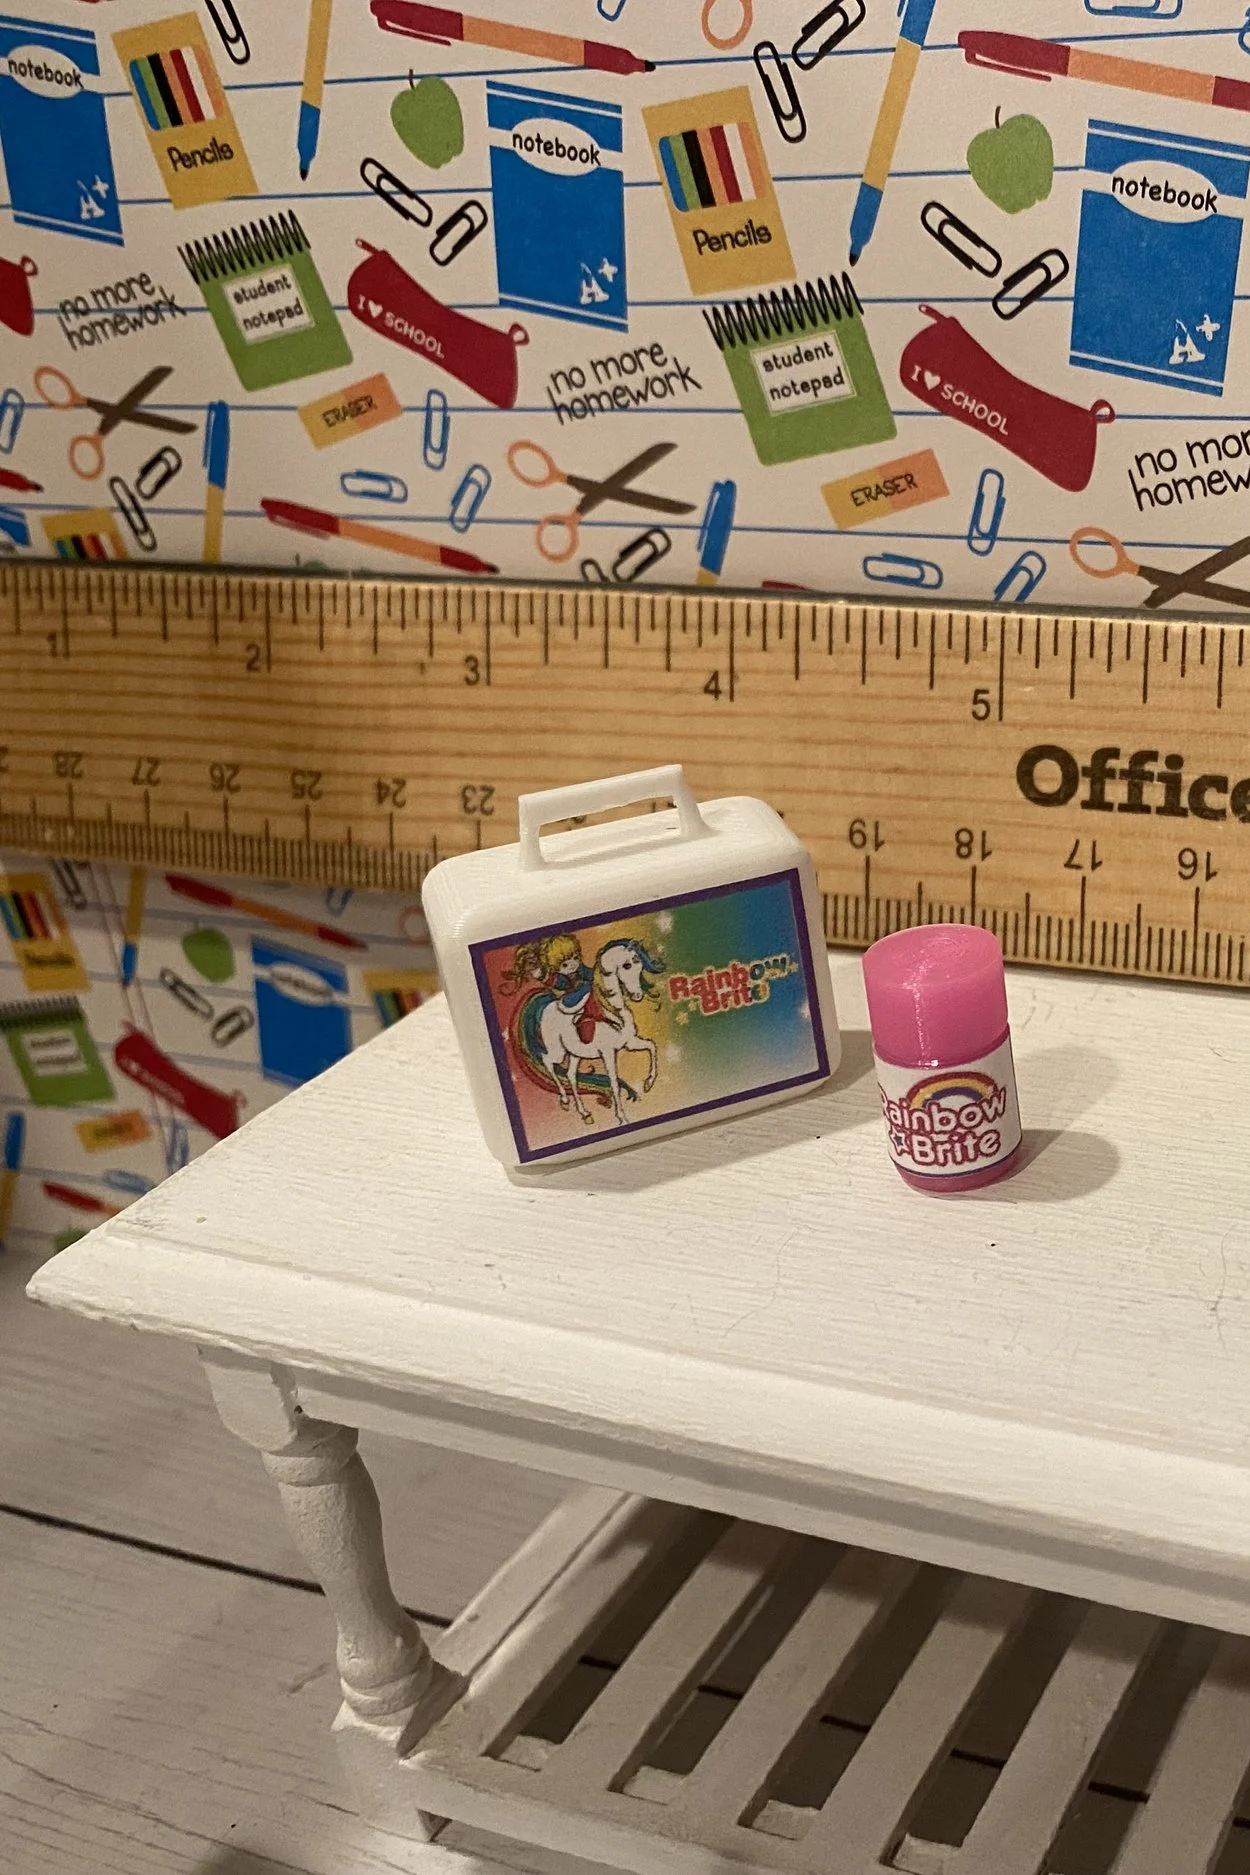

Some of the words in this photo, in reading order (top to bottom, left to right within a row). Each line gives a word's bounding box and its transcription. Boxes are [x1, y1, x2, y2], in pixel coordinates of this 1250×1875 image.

[8, 57, 84, 89] notebook
[167, 137, 235, 171] Pencils
[512, 132, 601, 167] notebook
[1111, 172, 1219, 214] notebook
[693, 219, 772, 256] Pencils
[62, 291, 90, 320] no
[91, 272, 152, 309] more
[233, 273, 292, 306] student
[57, 284, 188, 351] homework
[242, 301, 304, 332] notepad
[357, 294, 368, 314] I
[384, 311, 447, 360] SCHOOL
[549, 362, 588, 394] no
[589, 342, 670, 382] more
[762, 343, 835, 374] student
[546, 355, 702, 426] homework
[769, 366, 846, 402] notepad
[911, 364, 924, 383] I
[941, 382, 1010, 436] SCHOOL
[321, 395, 378, 429] ERASER
[1134, 447, 1181, 480] no
[851, 471, 918, 508] ERASER
[245, 643, 262, 673] 2
[463, 655, 481, 687] 3
[704, 670, 723, 701] 4
[971, 688, 992, 722] 5
[131, 757, 161, 786] 27
[209, 764, 241, 794] 26
[290, 769, 324, 800] 25
[374, 778, 408, 809] 24
[461, 785, 496, 817] 23
[848, 818, 887, 852] 19
[954, 827, 993, 862] 18
[1063, 839, 1104, 872] 17
[1177, 848, 1219, 882] 16
[669, 954, 788, 1004] Rainbow
[700, 981, 770, 1016] Brite
[911, 1127, 1002, 1167] Brite
